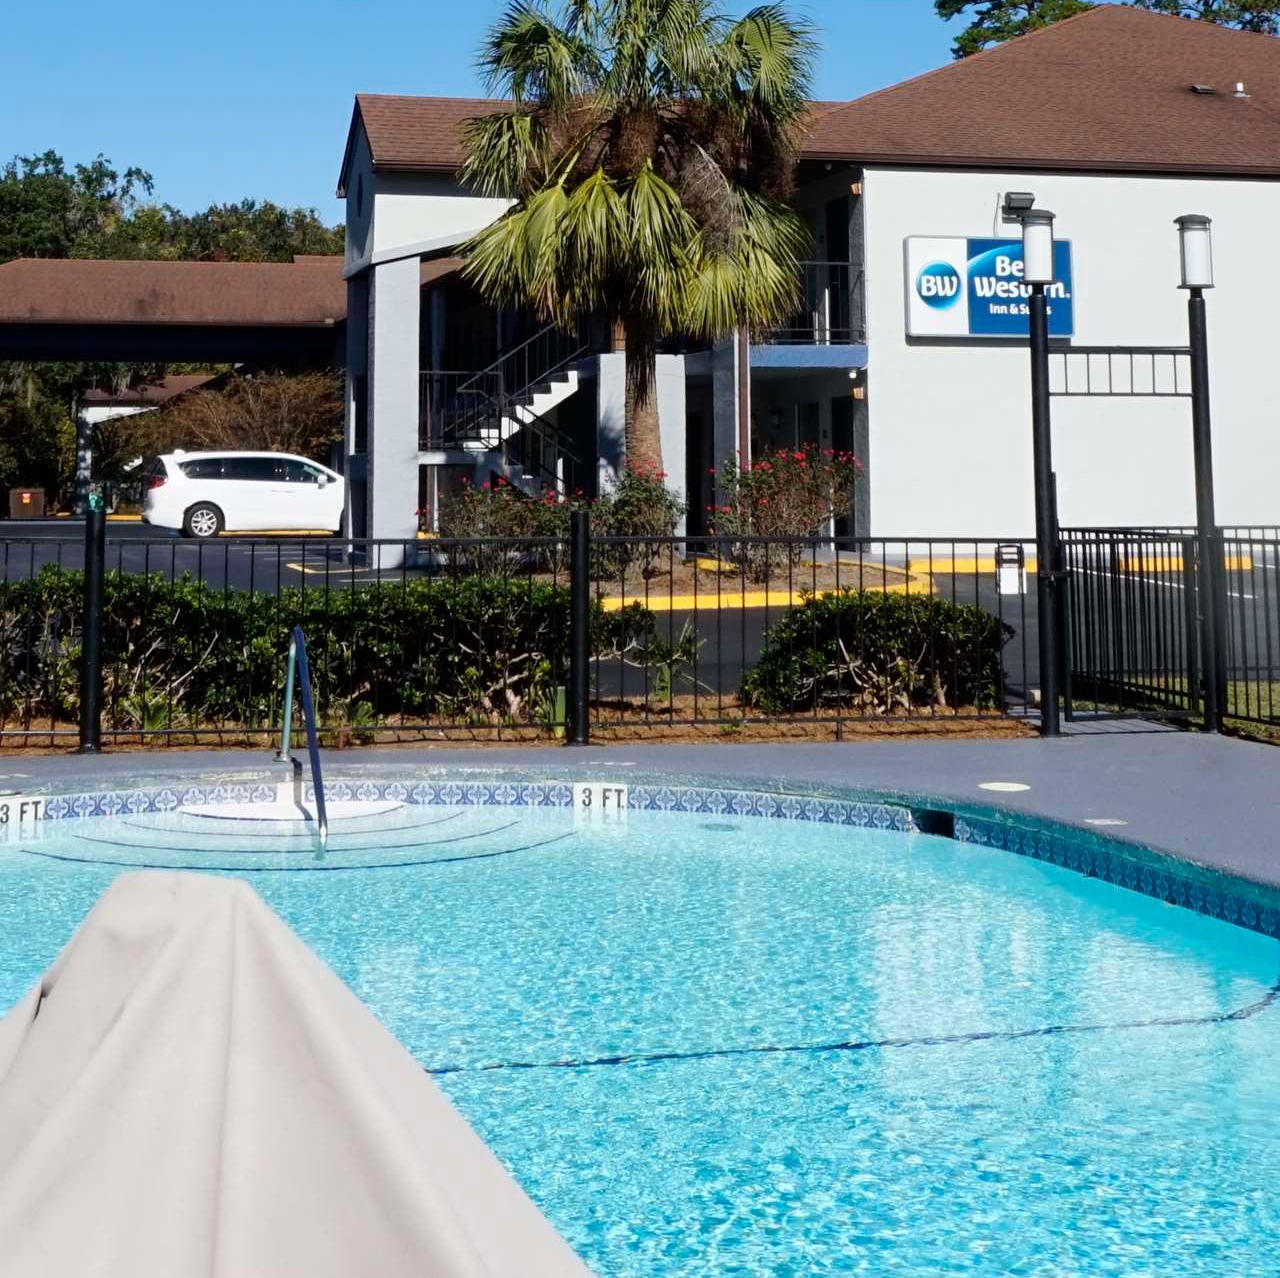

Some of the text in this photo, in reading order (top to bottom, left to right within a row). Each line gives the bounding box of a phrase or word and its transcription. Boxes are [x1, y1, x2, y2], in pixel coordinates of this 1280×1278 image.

[995, 255, 1025, 277] Be
[920, 274, 958, 297] BW
[989, 303, 1008, 315] Inn
[1009, 303, 1019, 315] &
[582, 787, 592, 807] 3
[0, 803, 10, 824] 3
